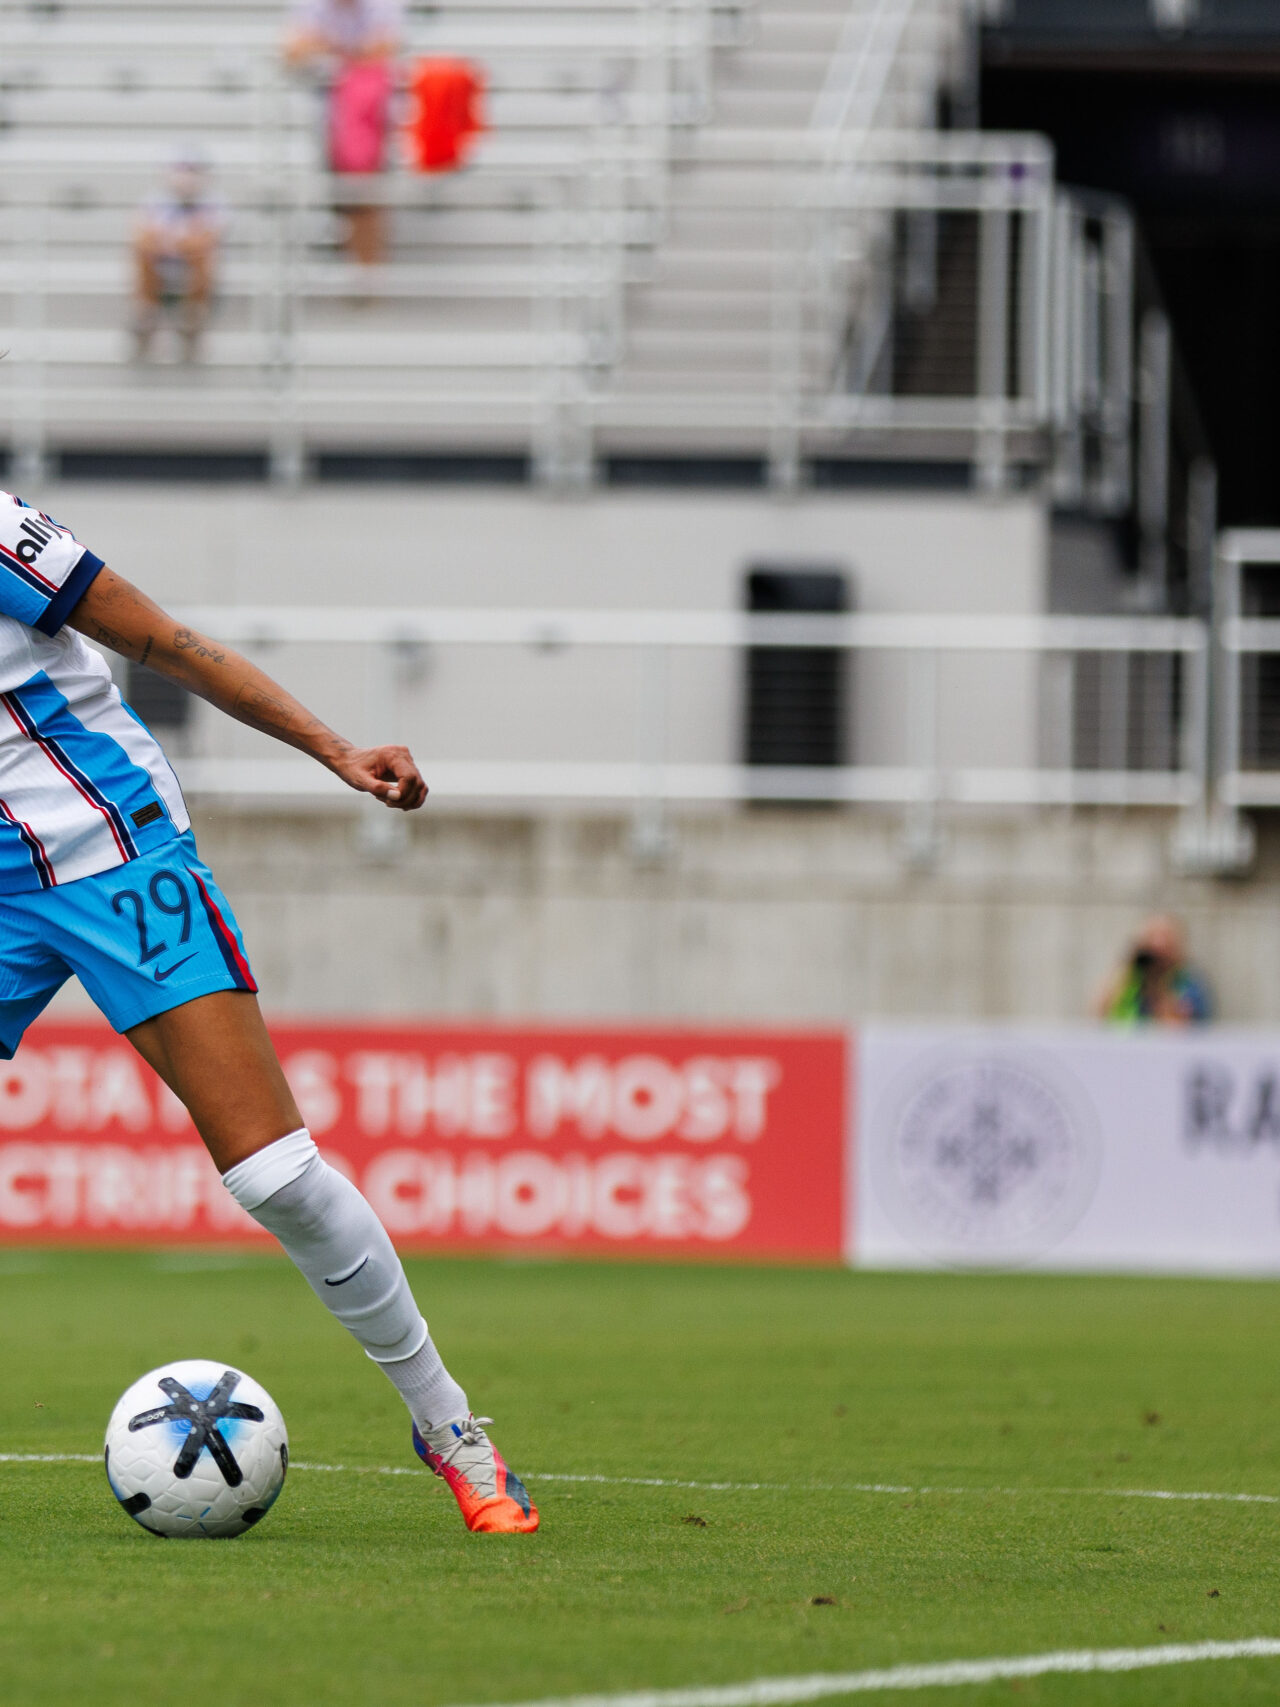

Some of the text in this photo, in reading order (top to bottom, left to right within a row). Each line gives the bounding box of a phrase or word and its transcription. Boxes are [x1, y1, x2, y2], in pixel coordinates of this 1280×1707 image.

[16, 511, 63, 564] ally
[110, 869, 191, 967] 29
[347, 1050, 517, 1139] THE
[526, 1054, 780, 1143] MOST
[363, 1148, 752, 1240] CHOICES
